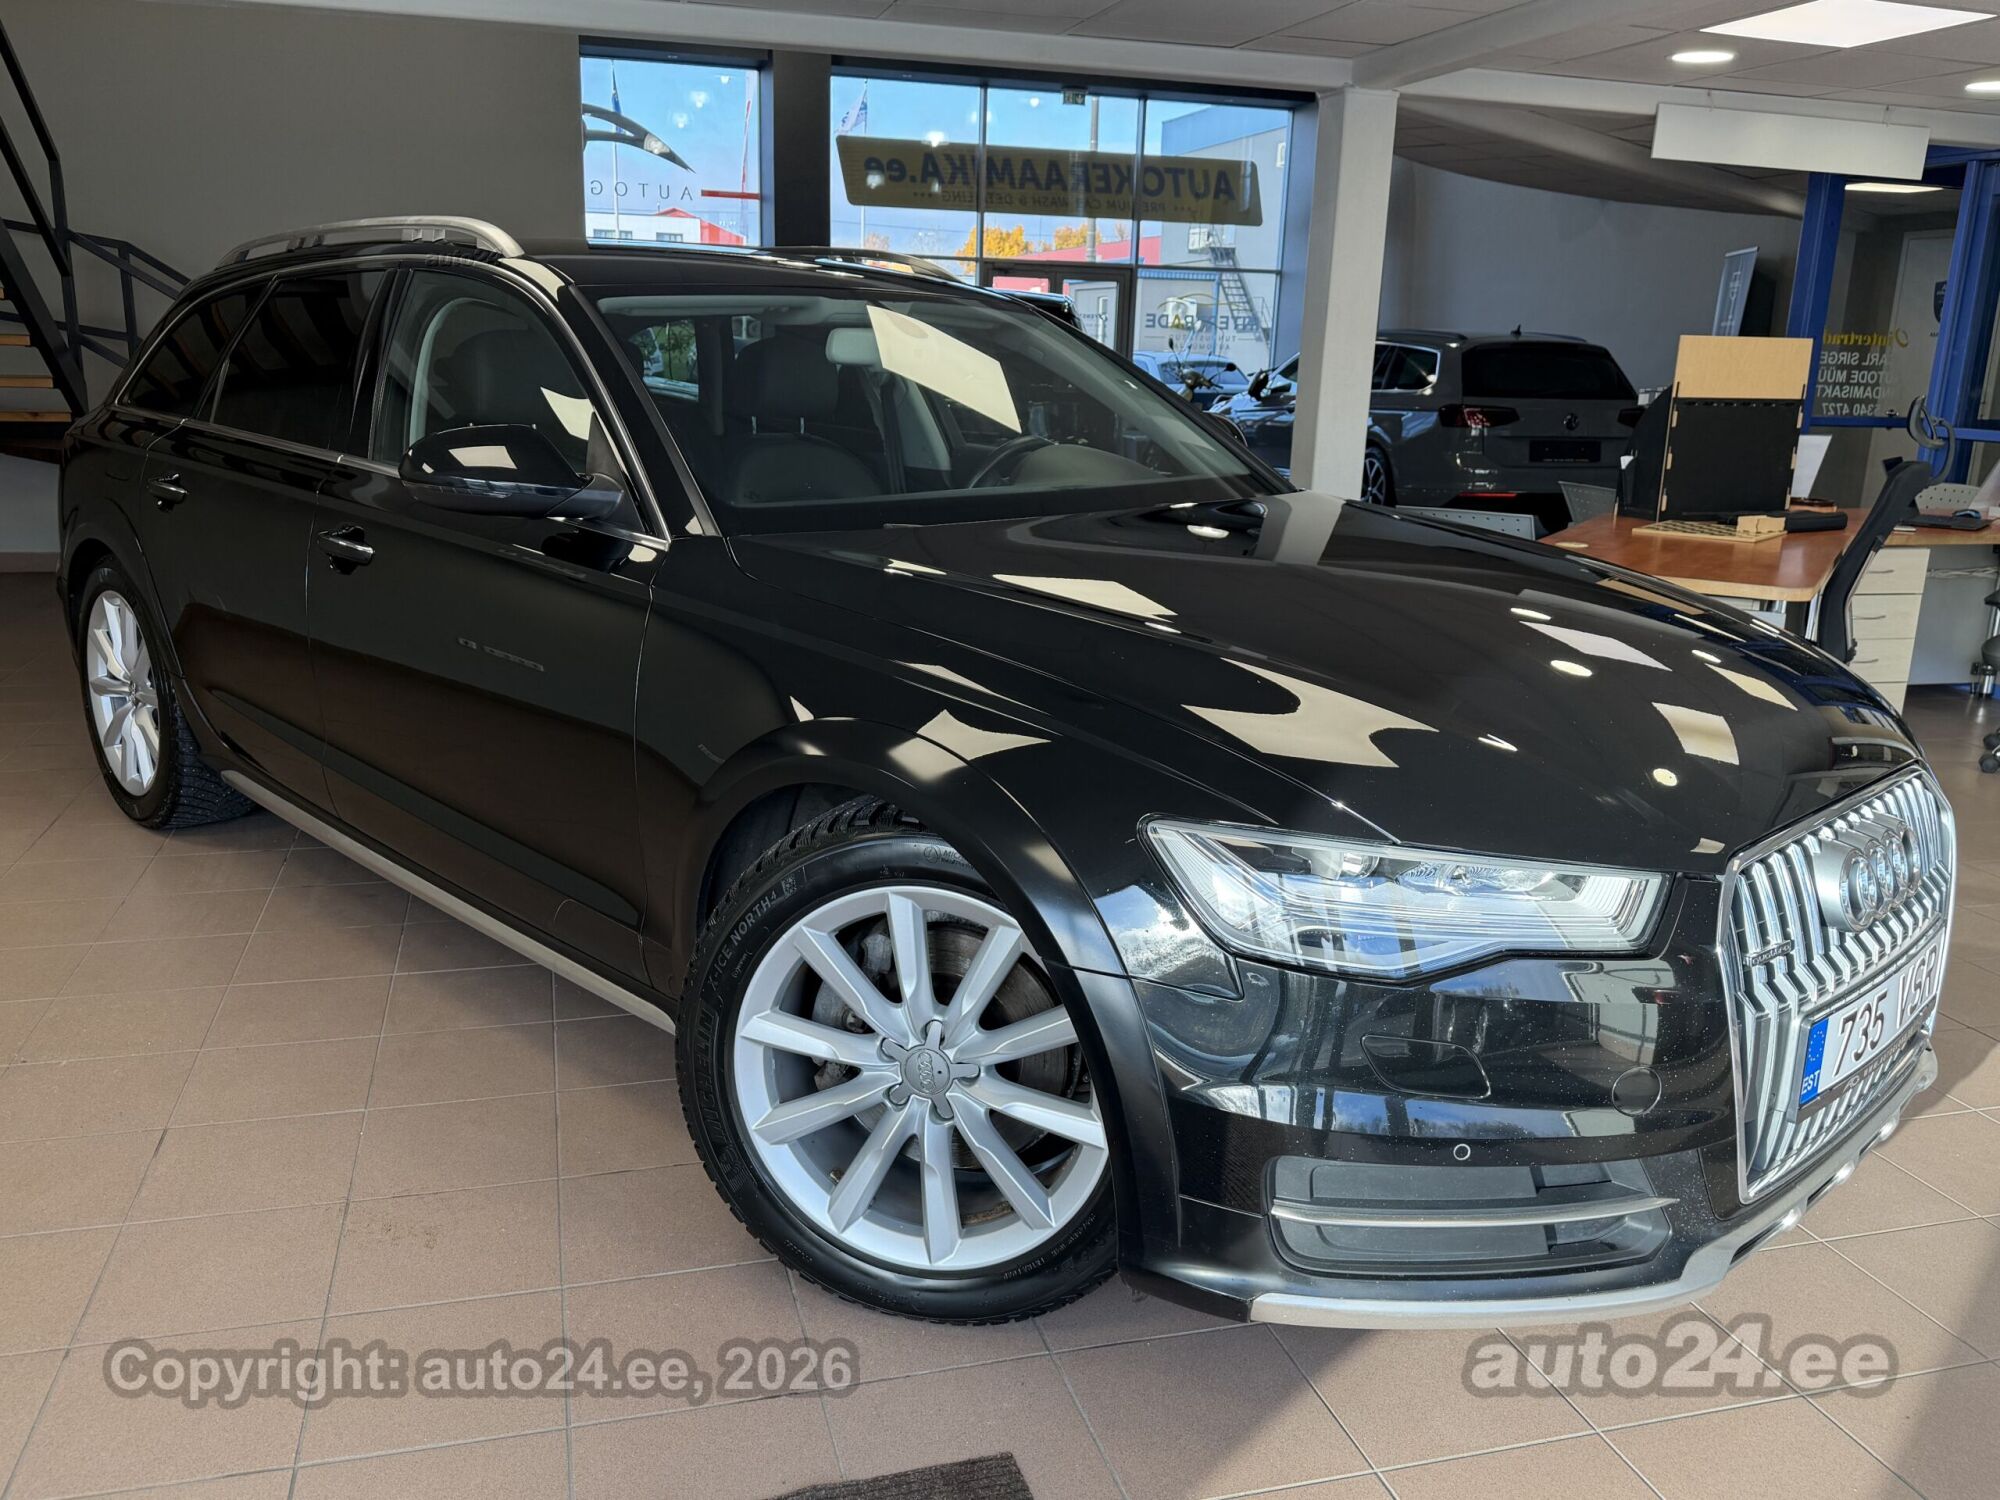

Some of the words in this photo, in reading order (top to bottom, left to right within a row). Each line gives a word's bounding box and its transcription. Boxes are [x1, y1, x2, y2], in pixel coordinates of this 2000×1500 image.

[729, 898, 772, 947] NORTH
[1831, 992, 1889, 1079] 735
[696, 1007, 733, 1147] MICHELIN
[1801, 1070, 1820, 1095] EST
